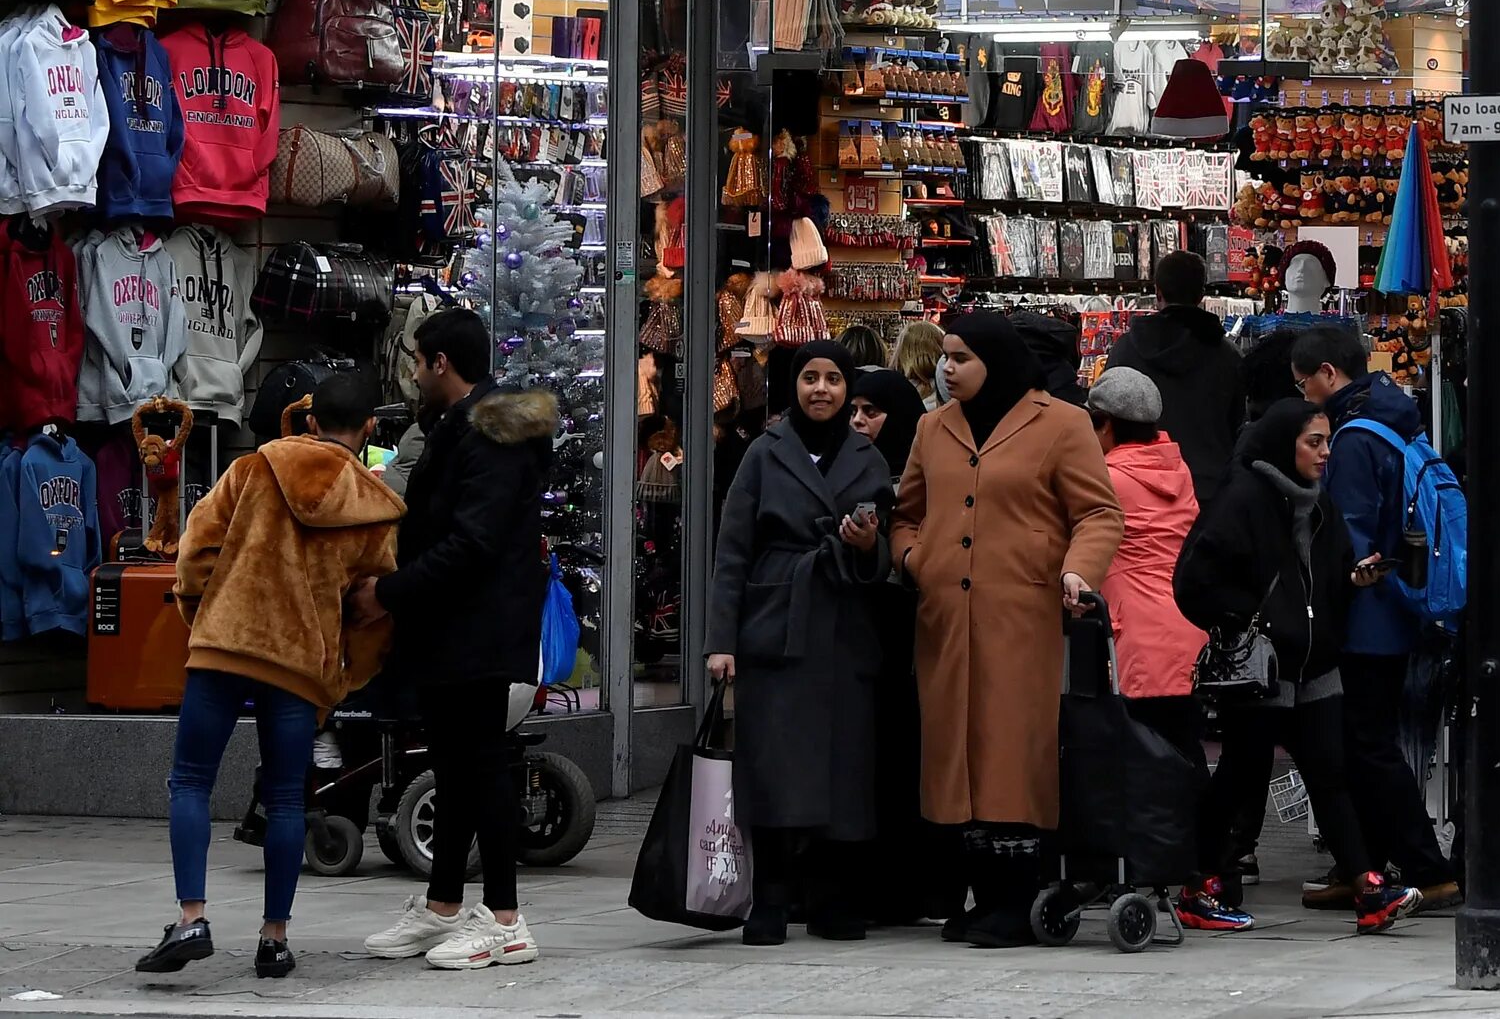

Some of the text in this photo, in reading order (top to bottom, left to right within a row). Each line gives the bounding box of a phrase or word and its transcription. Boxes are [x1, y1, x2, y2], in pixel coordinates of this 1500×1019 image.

[180, 67, 256, 106] LONDON
[1002, 82, 1022, 97] KING
[1450, 103, 1471, 116] No
[187, 111, 255, 128] ENGLAND
[1113, 252, 1133, 267] UEEN
[113, 275, 160, 312] OXFORD
[40, 476, 82, 518] OXFOR
[699, 839, 716, 852] can
[706, 855, 742, 875] IF YOU
